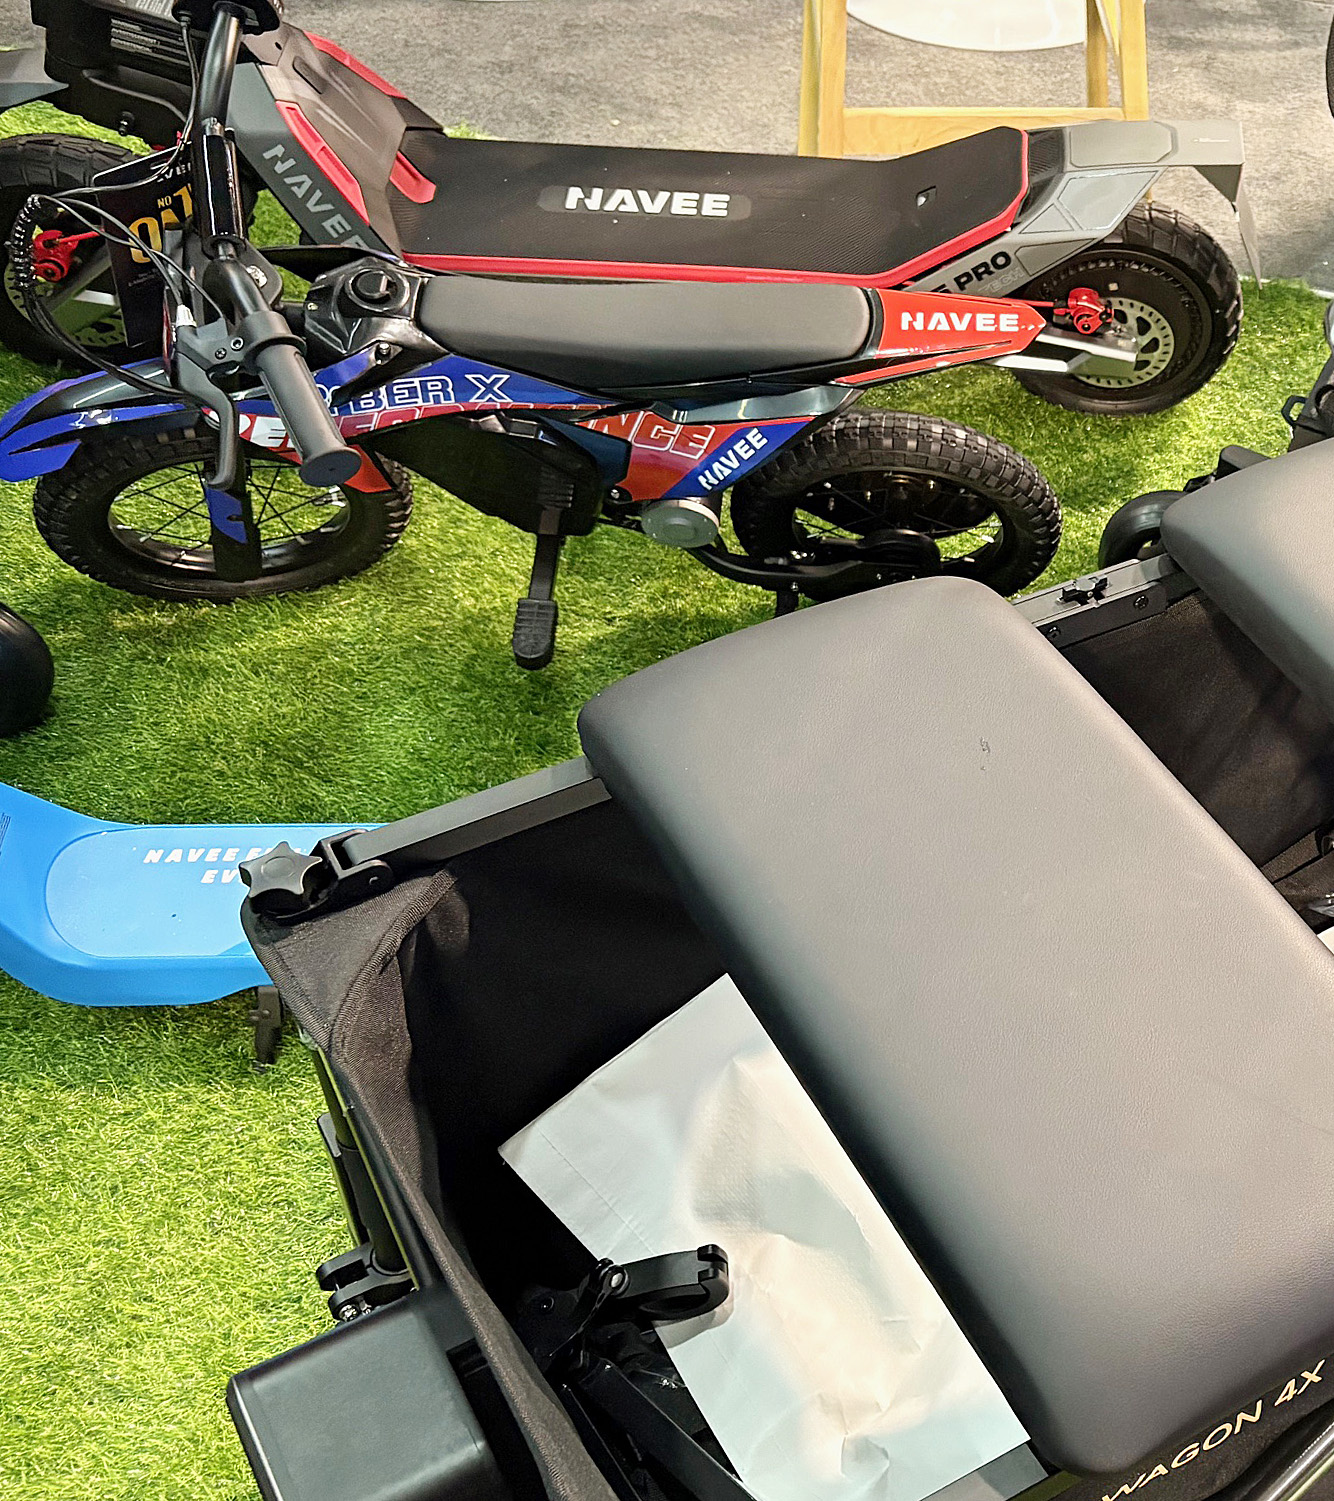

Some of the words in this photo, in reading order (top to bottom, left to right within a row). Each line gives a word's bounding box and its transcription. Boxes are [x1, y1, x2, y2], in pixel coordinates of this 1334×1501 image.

[565, 186, 731, 217] NAVEE
[953, 251, 1012, 291] PRO
[901, 311, 1019, 332] NAVEE
[465, 374, 513, 402] X
[697, 427, 769, 491] NAVEE
[143, 848, 240, 864] NAVEE
[201, 869, 240, 884] EV
[1101, 1400, 1262, 1501] WAGON
[1274, 1359, 1326, 1406] 4X
